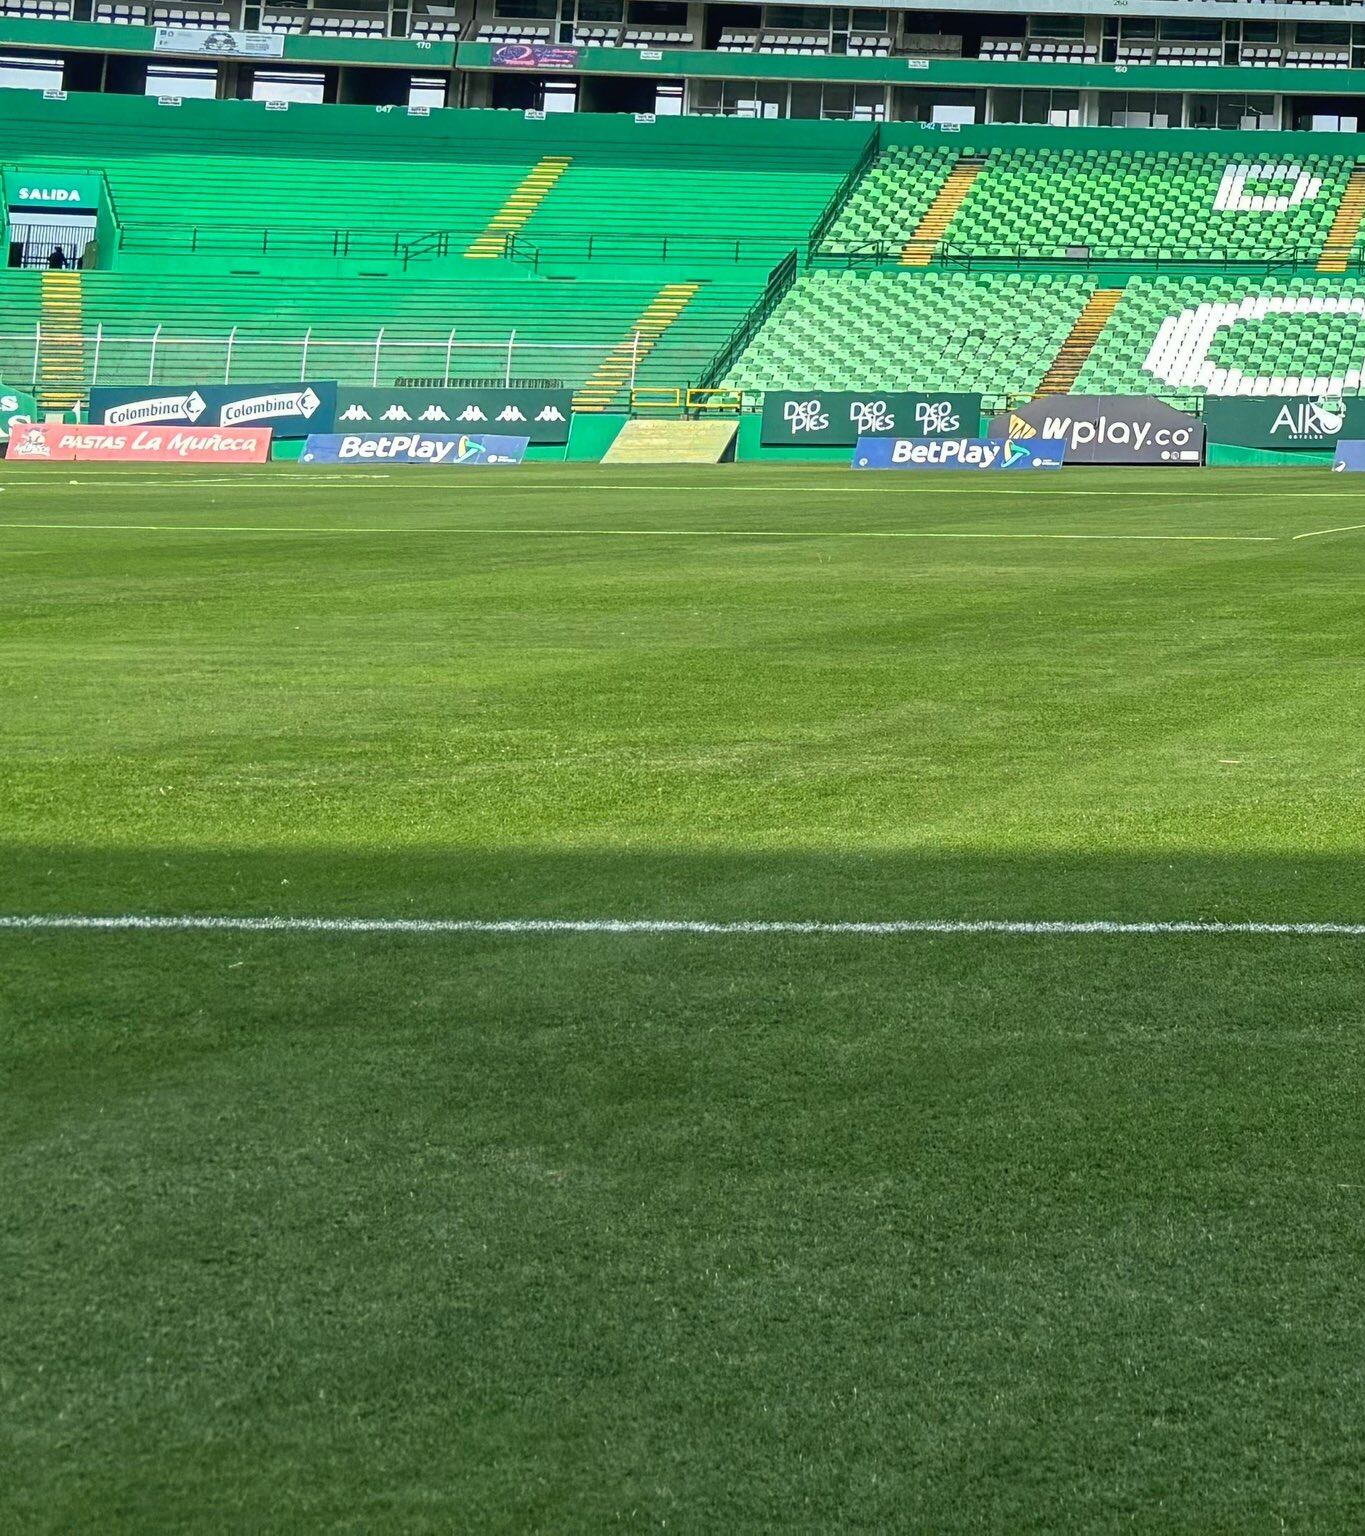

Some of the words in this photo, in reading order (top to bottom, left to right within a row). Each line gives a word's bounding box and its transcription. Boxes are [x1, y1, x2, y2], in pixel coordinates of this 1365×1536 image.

[19, 188, 80, 201] SALIDA
[110, 402, 179, 424] Colombina
[226, 398, 294, 420] Colombina
[784, 400, 820, 420] DEO
[850, 400, 886, 420] DEO
[916, 401, 952, 422] DEO
[792, 414, 829, 434] PIES
[858, 414, 894, 434] PIES
[923, 414, 960, 435] PIES
[59, 434, 126, 450] PASTAS
[132, 431, 162, 450] La
[171, 432, 257, 458] Muñeca
[338, 434, 454, 462] BetPlay
[892, 440, 1000, 468] BetPlay
